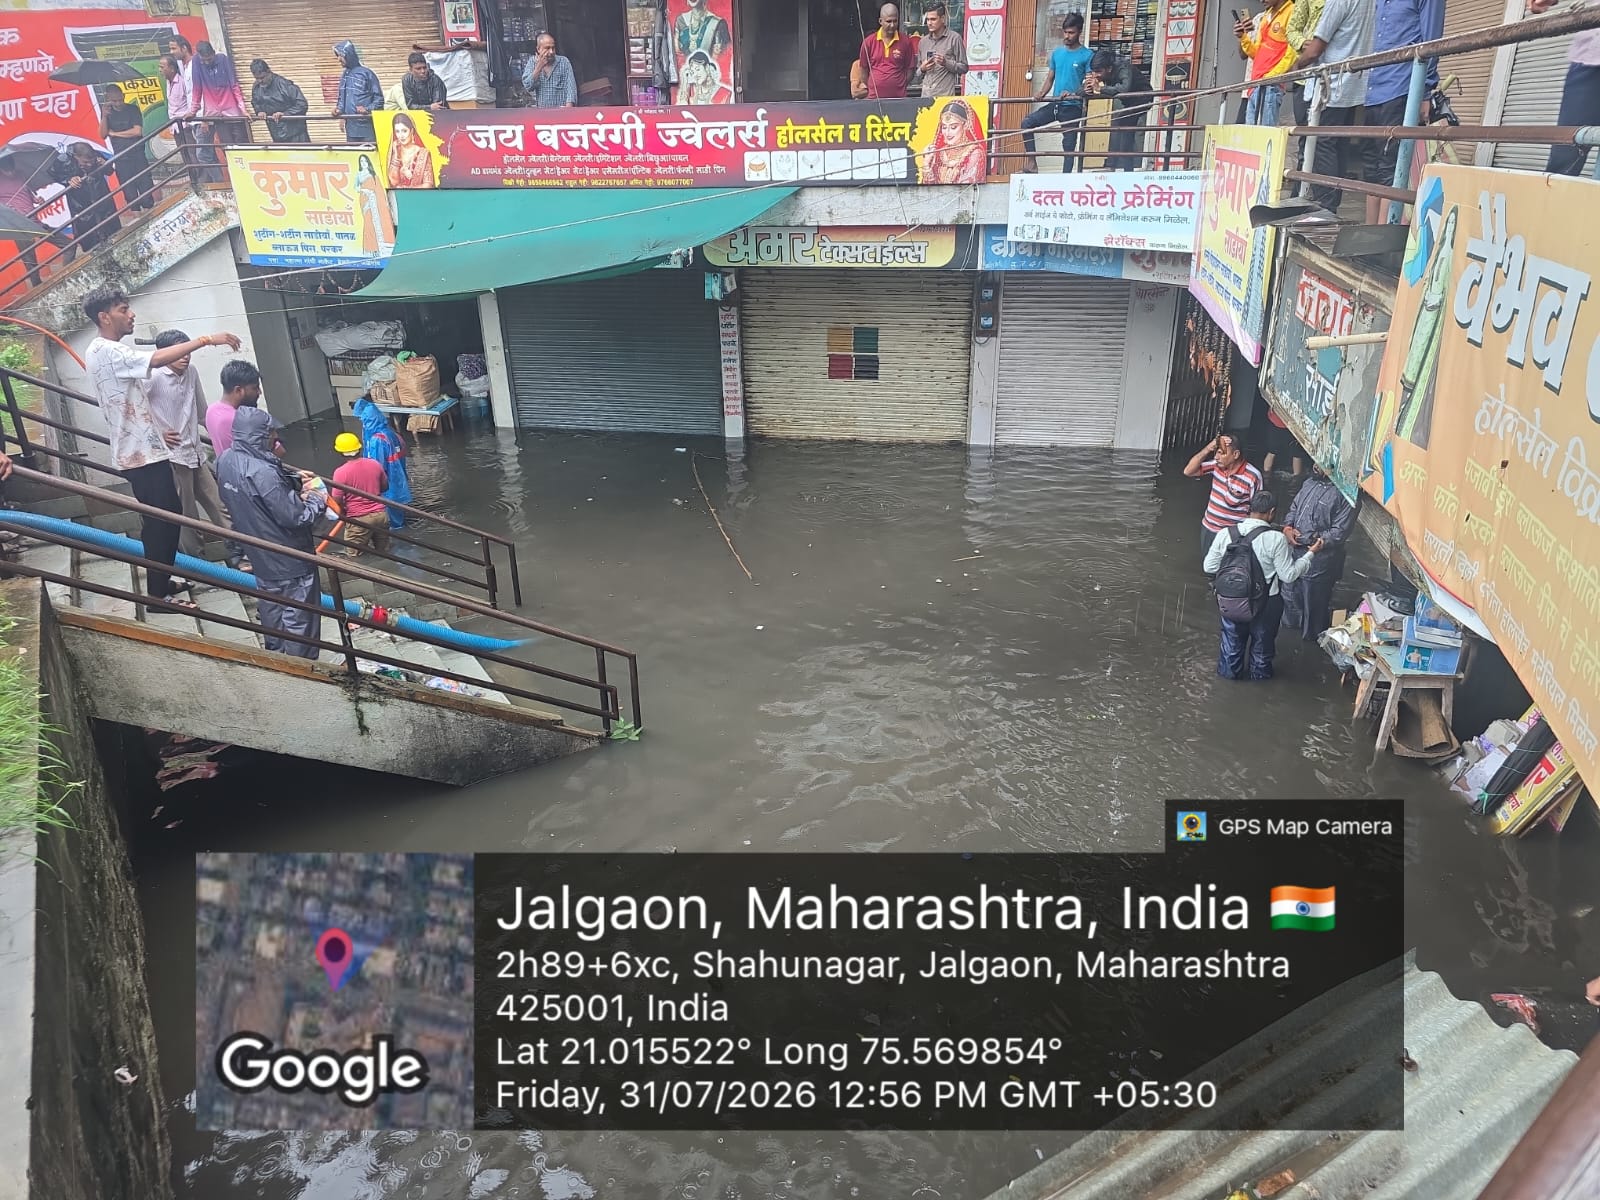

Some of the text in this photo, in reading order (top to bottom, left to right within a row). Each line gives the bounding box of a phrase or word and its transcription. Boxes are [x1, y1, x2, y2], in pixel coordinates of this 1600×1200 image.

[31, 89, 79, 118] चहा
[138, 93, 157, 105] चहा
[466, 108, 911, 151] जय बजरंगी ज्वेलर्स होलसेल व रिटेल
[471, 167, 481, 175] AD
[248, 162, 354, 217] कुमार
[1032, 183, 1195, 210] दत्त फोटो फ्रेमिंग
[727, 226, 819, 265] अमर
[1103, 235, 1146, 248] झेरॉक्स
[1453, 190, 1591, 396] वैभव
[1474, 383, 1600, 526] होलसेल विक्र
